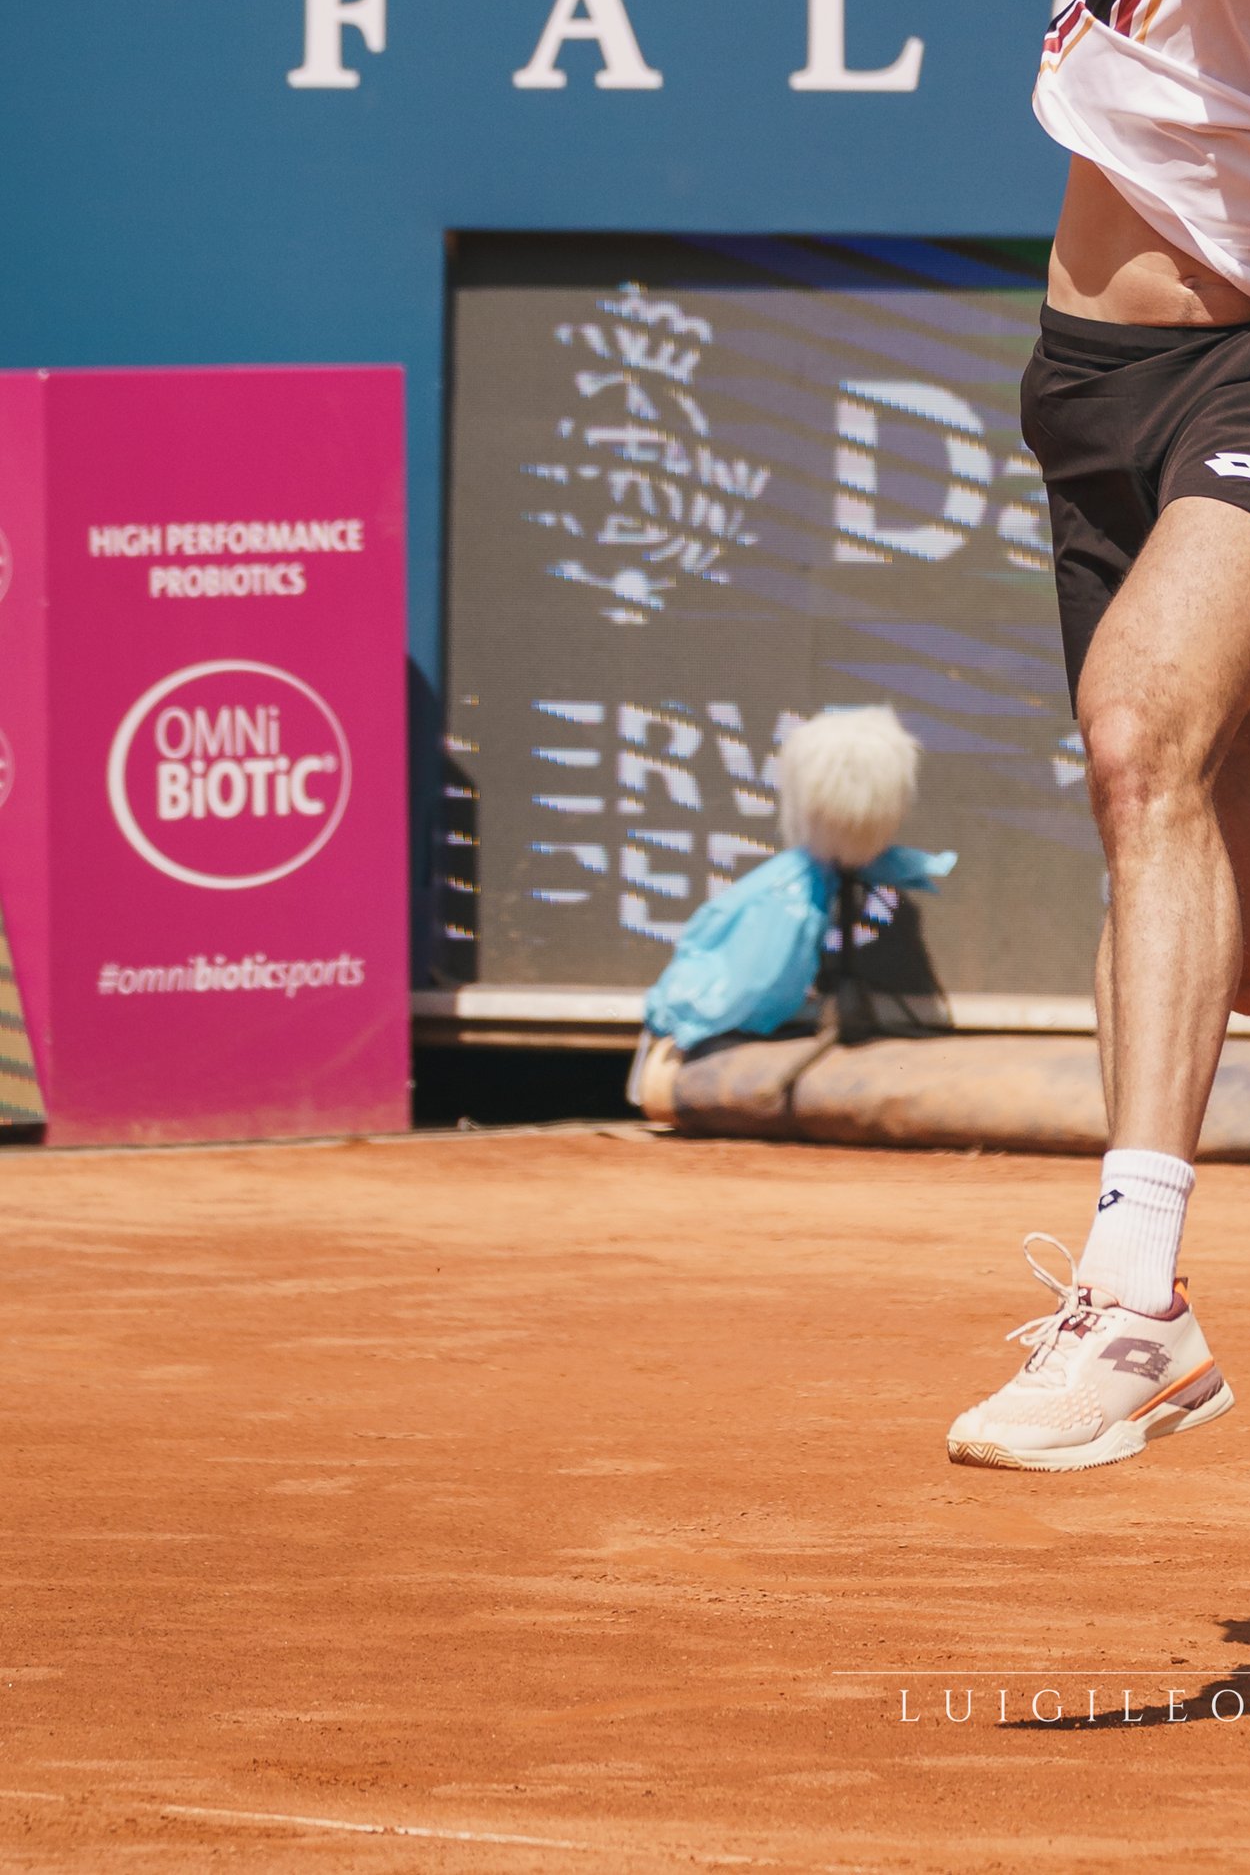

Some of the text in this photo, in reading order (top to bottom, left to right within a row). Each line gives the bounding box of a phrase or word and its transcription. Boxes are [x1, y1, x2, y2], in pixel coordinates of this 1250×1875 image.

[89, 519, 365, 557] HIGH PERFORMANCE
[149, 562, 307, 598] PROBIOTICS
[97, 949, 366, 999] #omnibioticsports
